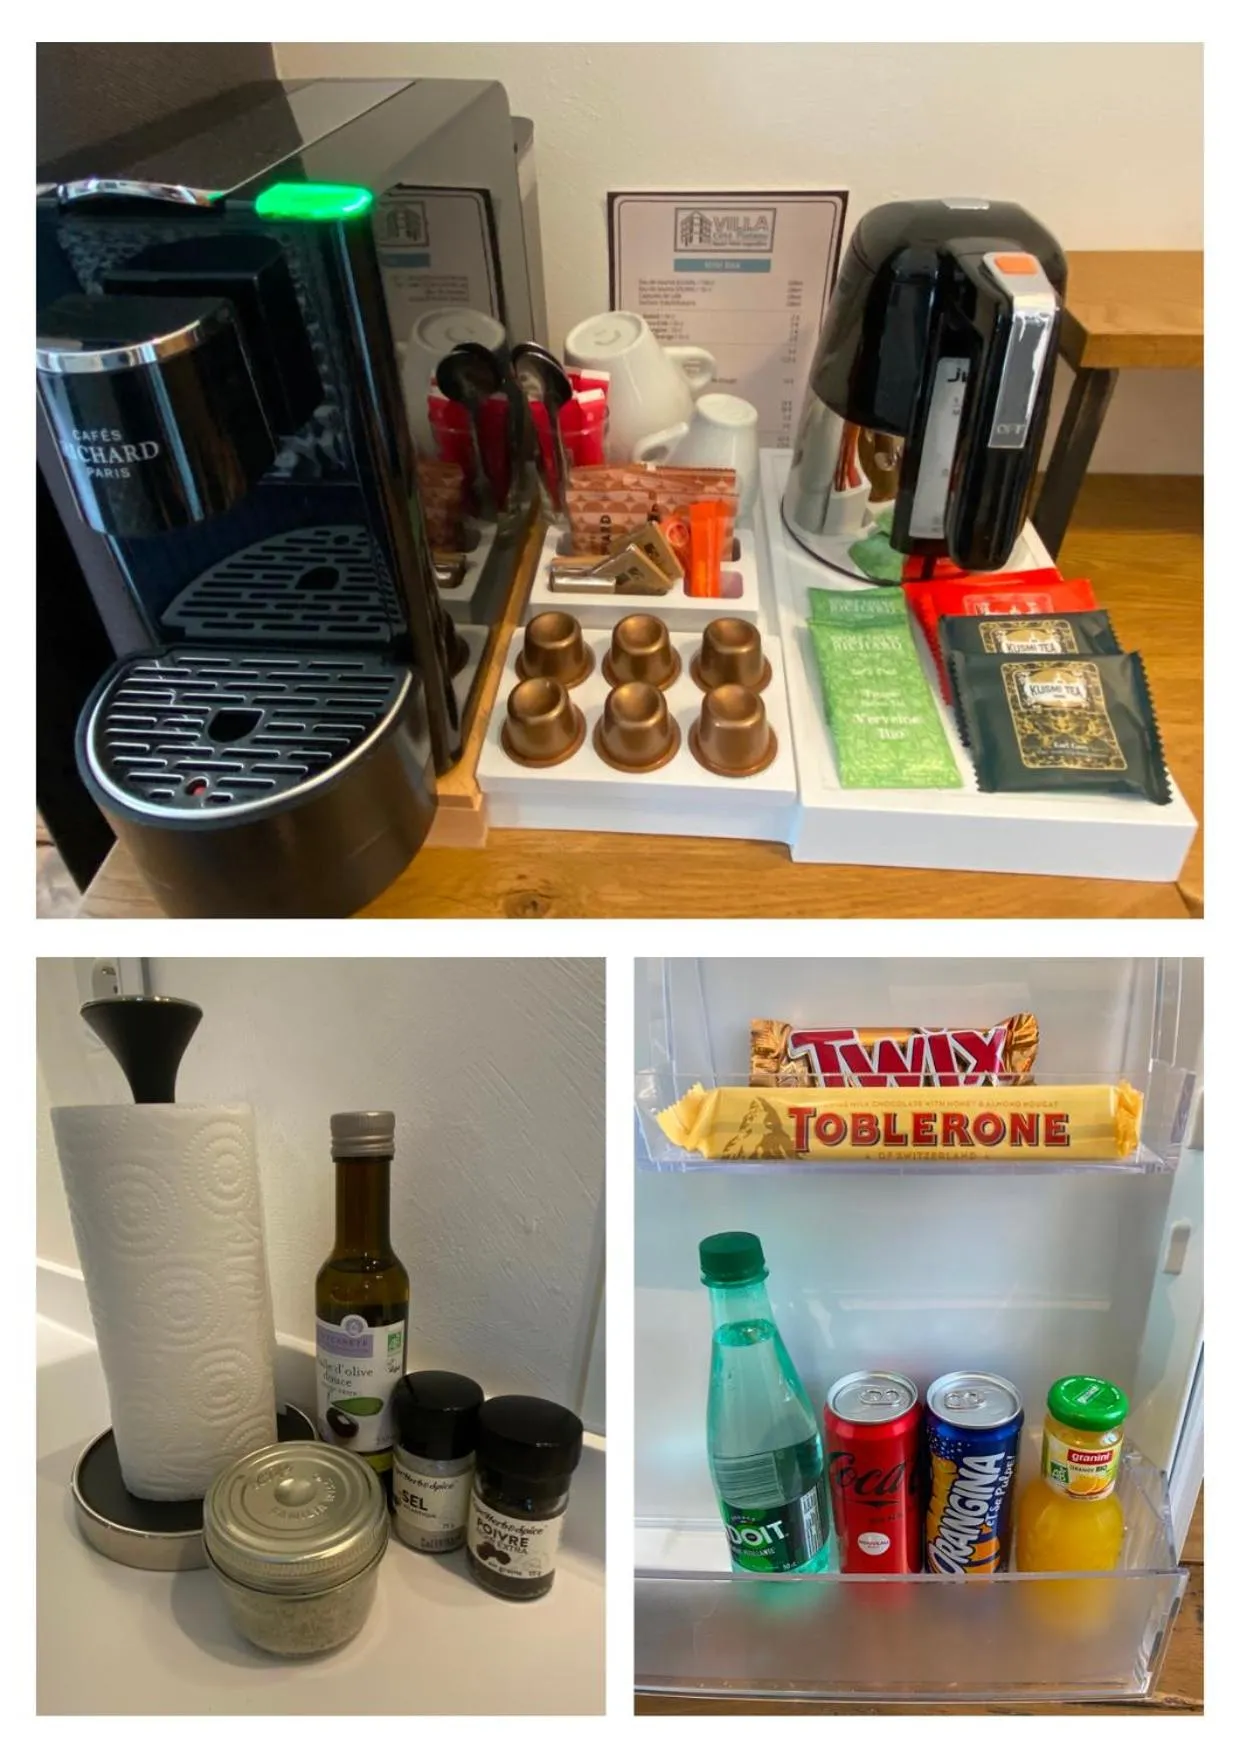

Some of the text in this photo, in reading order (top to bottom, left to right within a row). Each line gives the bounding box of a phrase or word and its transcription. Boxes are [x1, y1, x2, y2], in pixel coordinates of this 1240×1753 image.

[713, 215, 769, 231] VILLA
[71, 427, 122, 442] CAFÉS
[86, 466, 131, 479] PARIS
[1038, 642, 1057, 651] TEA
[1029, 684, 1082, 697] KUSMI TEA
[789, 1026, 1007, 1088] TWIX
[788, 1106, 1070, 1152] TOBLERONE
[896, 1151, 977, 1160] SWITZERLAND
[335, 1363, 374, 1377] d'olive
[1071, 1452, 1110, 1462] granini
[828, 1451, 907, 1496] Coca
[401, 1489, 428, 1511] SEL
[927, 1451, 1007, 1574] ORANGINA
[476, 1516, 530, 1548] POIVRE
